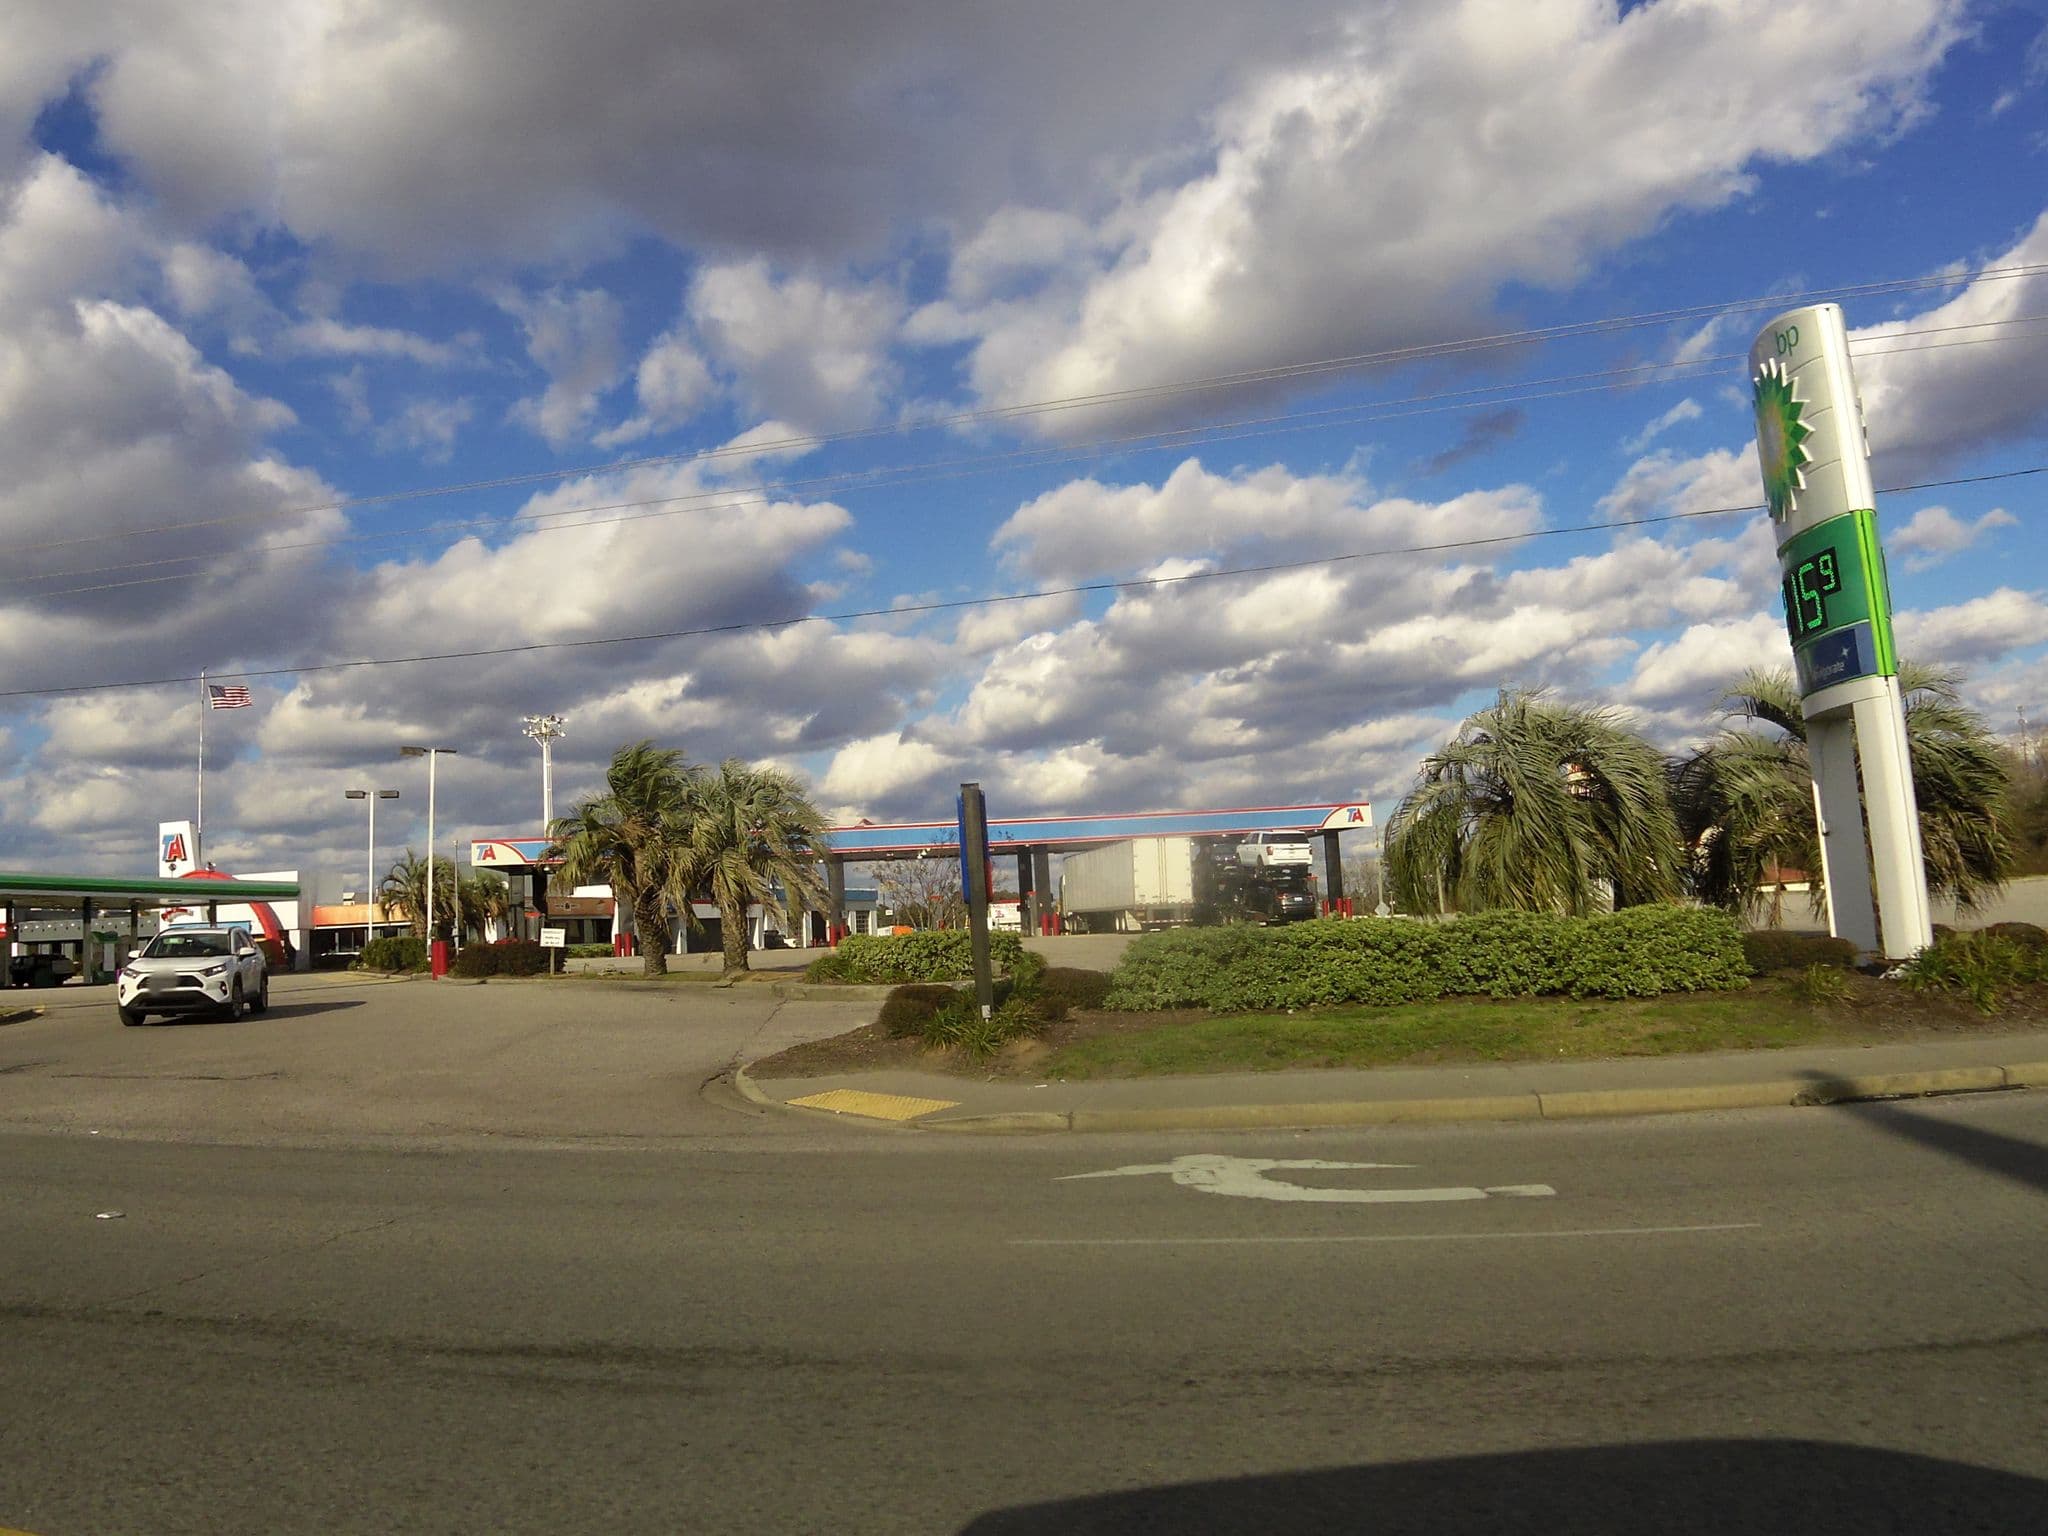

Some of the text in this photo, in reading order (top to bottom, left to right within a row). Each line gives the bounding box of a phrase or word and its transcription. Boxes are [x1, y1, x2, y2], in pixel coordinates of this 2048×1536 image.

[1775, 325, 1799, 357] bp
[1347, 807, 1364, 823] TA
[162, 833, 188, 863] TA
[476, 844, 496, 861] TA
